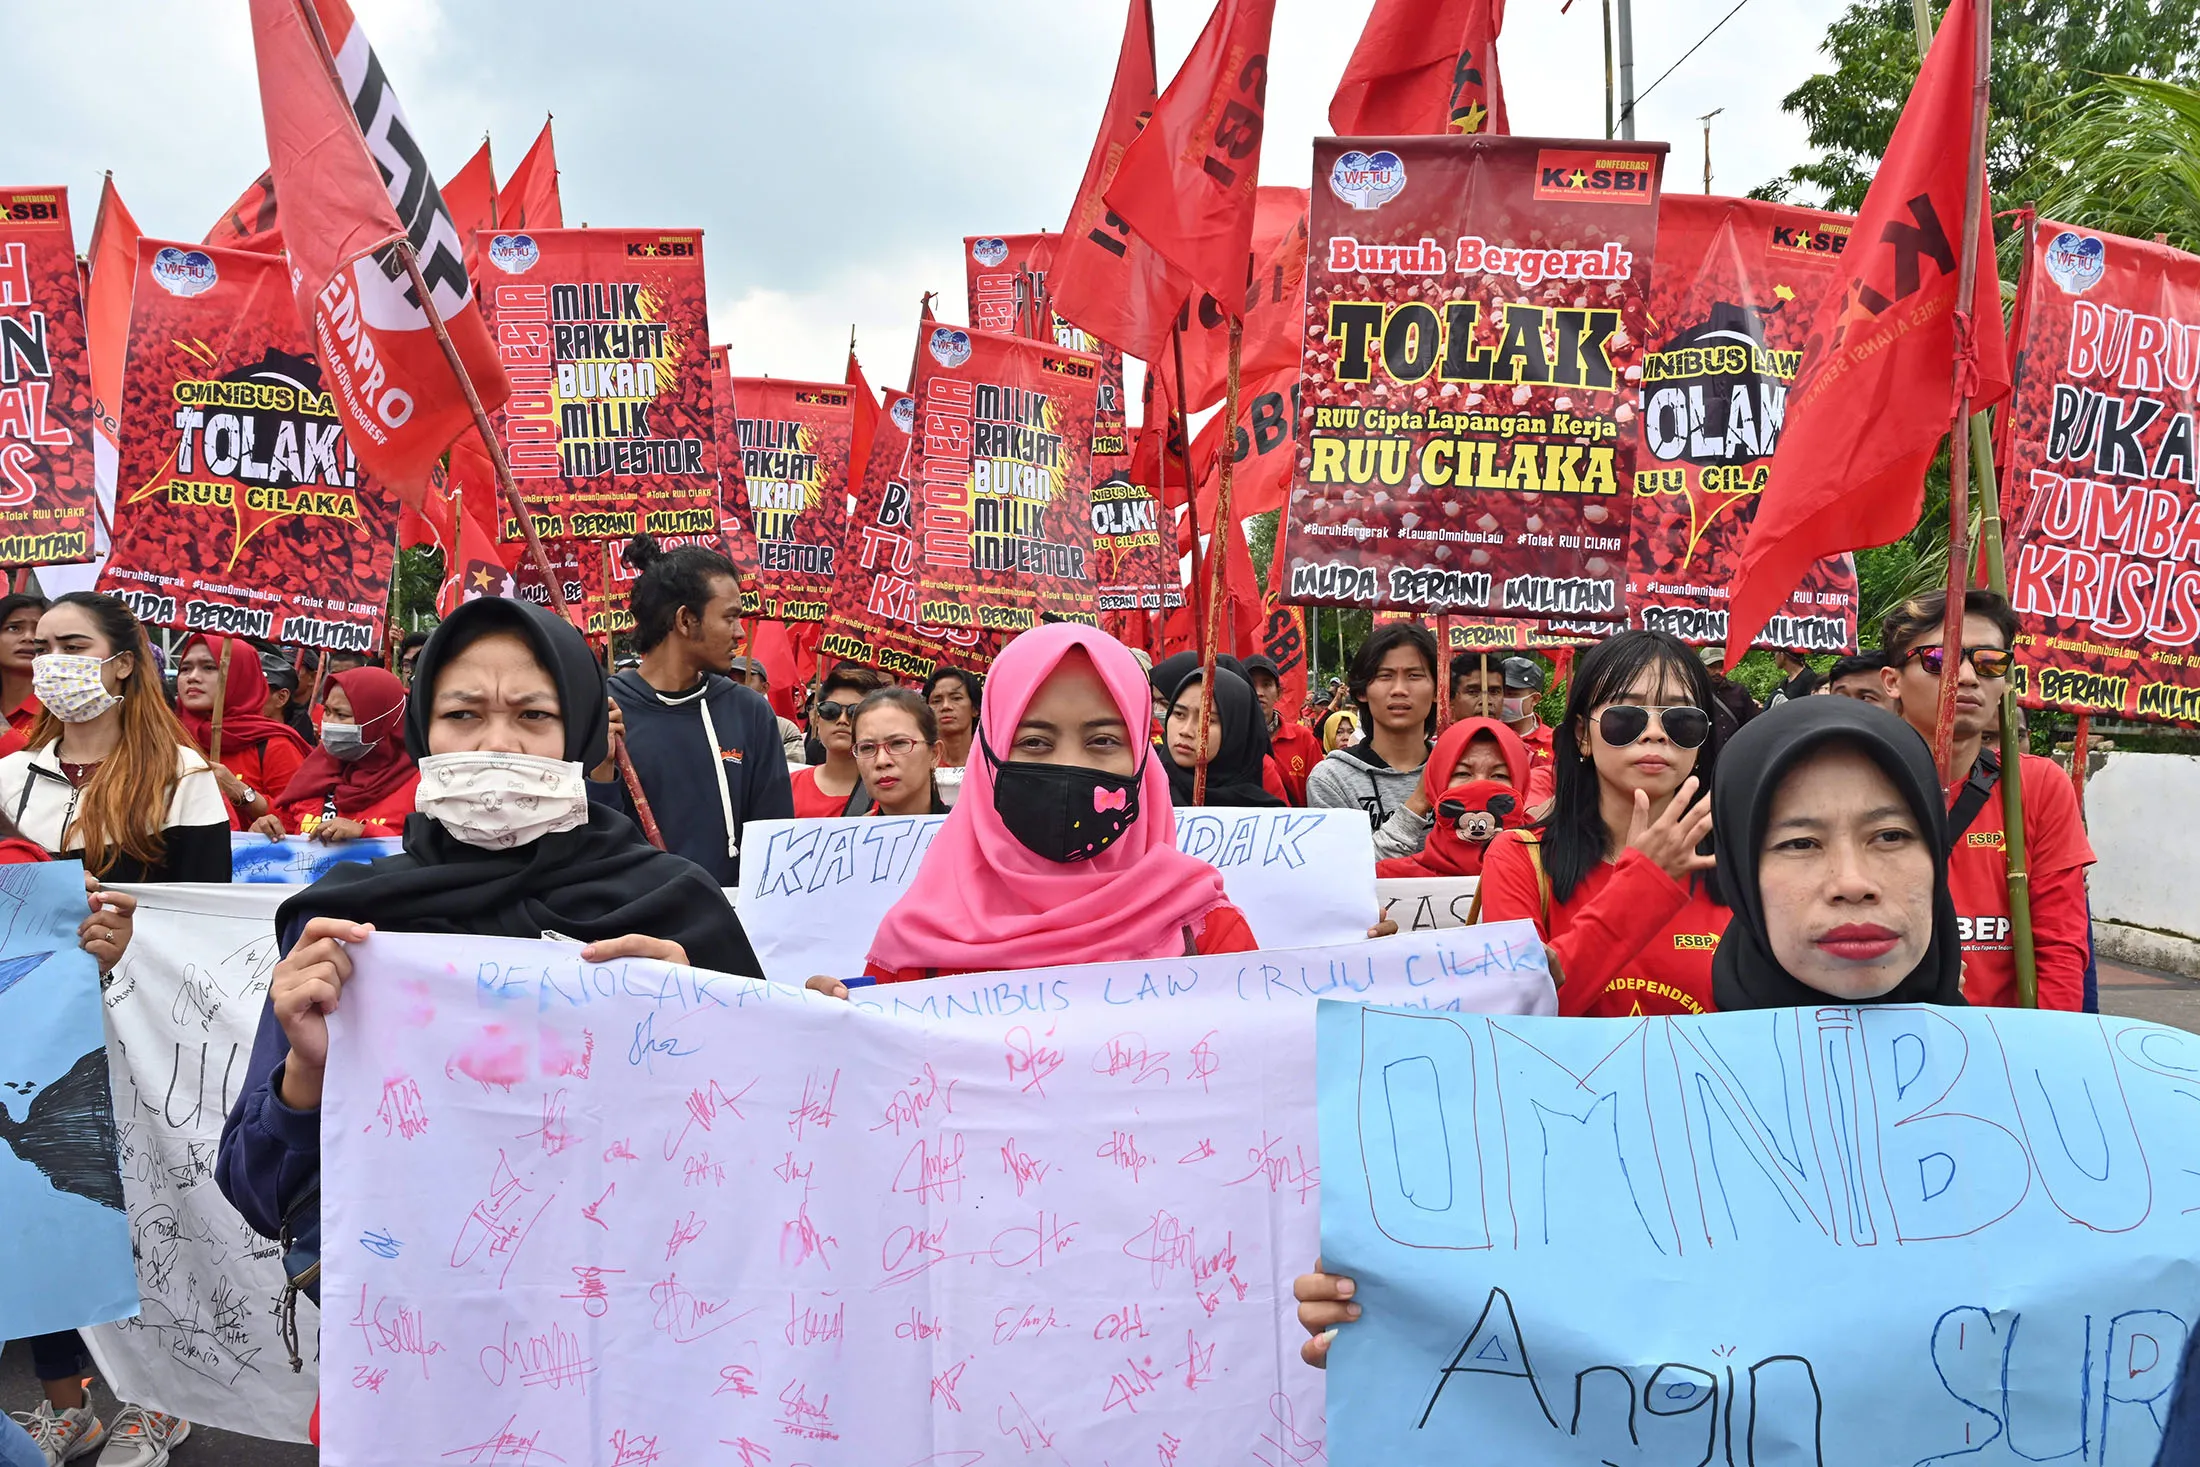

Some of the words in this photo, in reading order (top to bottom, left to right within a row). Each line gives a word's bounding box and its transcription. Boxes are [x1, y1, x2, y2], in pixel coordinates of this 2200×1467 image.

[1344, 168, 1391, 186] WFTU
[1541, 167, 1648, 191] KASBI
[1595, 159, 1649, 170] KONFEDERASI
[0, 203, 58, 219] SBI
[1819, 223, 1852, 236] KONFEDER
[498, 246, 529, 258] WFTU
[627, 243, 694, 256] KASBI
[1328, 237, 1446, 274] Buruh
[1455, 237, 1632, 286] Bergerak
[2056, 251, 2094, 271] WFTU
[164, 263, 204, 279] WFTU
[551, 283, 642, 321] MILIK
[553, 323, 668, 361] RAKYAT
[937, 339, 964, 352] WFTU
[1328, 301, 1622, 391] TOLAK
[2067, 300, 2200, 392] BURU
[495, 284, 560, 478] INDONESIA
[557, 362, 657, 398] BUKAN
[1043, 357, 1093, 379] KASBI
[1641, 346, 1747, 381] MNIBUS
[173, 380, 295, 411] OMNIBUS
[299, 389, 338, 416] LA
[796, 392, 847, 406] KASBI
[974, 383, 1047, 429] MILIK
[560, 401, 652, 439] MILIK
[1315, 407, 1359, 428] RUU
[1364, 409, 1423, 434] Cipta
[1427, 410, 1547, 436] Lapangan
[1551, 414, 1617, 441] Kerja
[1639, 383, 1787, 460] OLAK
[174, 406, 357, 487] TOLAK!
[974, 422, 1062, 468] RAKYAT
[2046, 383, 2200, 496] BUKA
[562, 438, 704, 478] INVESTOR
[742, 449, 818, 482] AKYAT
[923, 376, 972, 567] INDONESIA
[1309, 437, 1411, 485] RUU
[1421, 438, 1617, 494] CILAKA
[169, 479, 232, 506] RUU
[247, 486, 358, 517] CILAKA
[647, 490, 669, 499] #Tolak
[672, 490, 686, 499] RUU
[688, 488, 712, 498] CILAKA
[747, 479, 805, 511] UKAN
[974, 459, 1051, 502] BUKAN
[1091, 486, 1128, 502] NIBUS
[1634, 469, 1685, 496] UU
[1700, 465, 1770, 493] CILA
[0, 511, 28, 520] #Tolak
[33, 509, 50, 519] RUU
[54, 508, 85, 517] CILAKA
[506, 513, 563, 539] MDA
[571, 511, 636, 536] BERANI
[646, 508, 714, 533] MILITAN
[752, 510, 800, 542] ILIK
[974, 497, 1047, 539] MILIK
[1092, 500, 1157, 535] OLAK!
[2019, 468, 2200, 565] TUMBA
[1115, 534, 1160, 548] CILAKA
[1303, 523, 1389, 539] #BuruhBergerak
[1398, 527, 1503, 544] #LawanOmnibusLaw
[1518, 533, 1553, 547] #Tolak
[1559, 535, 1580, 549] RUU
[1584, 537, 1621, 550] CILAKA
[758, 542, 834, 575] ESTOR
[974, 534, 1086, 580] INVESTOR
[108, 567, 185, 587] #BuruhBergerak
[192, 579, 282, 602] #LawanOmnibusLaw
[292, 596, 323, 608] #Tolak
[327, 599, 345, 611] RUU
[348, 602, 378, 616] CILAKA
[521, 583, 552, 603] MUD
[1099, 594, 1137, 609] BERANI
[1142, 593, 1182, 608] MILTAN
[1291, 563, 1378, 600] MUDA
[1390, 568, 1490, 607] BERANI
[1504, 575, 1615, 612] MILITAN
[1647, 582, 1730, 598] #LawanOmnibusL
[1793, 591, 1812, 604] RUU
[1816, 593, 1849, 606] CILAKA
[2013, 544, 2200, 647] KRISIS
[186, 600, 272, 639] BERANI
[281, 615, 373, 650] MILITAN
[588, 611, 636, 634] MDA
[782, 599, 828, 621] MILITA
[921, 599, 973, 625] MUDA
[978, 603, 1035, 630] BERANI
[1641, 606, 1729, 641] BERAN
[1263, 608, 1303, 677] SBI
[1450, 625, 1517, 647] BERANI
[2045, 636, 2139, 660] #LawanOmnibusLaw
[2151, 651, 2183, 666] #Tolak
[2186, 655, 2200, 669] RU
[822, 634, 873, 662] MUDA
[879, 647, 936, 681] BERANI
[2039, 666, 2128, 711] BERANI
[2137, 681, 2200, 722] MILIT
[1967, 832, 2001, 845] FSBP
[1674, 934, 1713, 947] FSBP
[1104, 965, 1199, 1002] LAW
[1605, 977, 1711, 1016] NDEPENDEN
[1415, 1285, 1824, 1467] Angin
[1912, 1304, 2190, 1467] SUR
